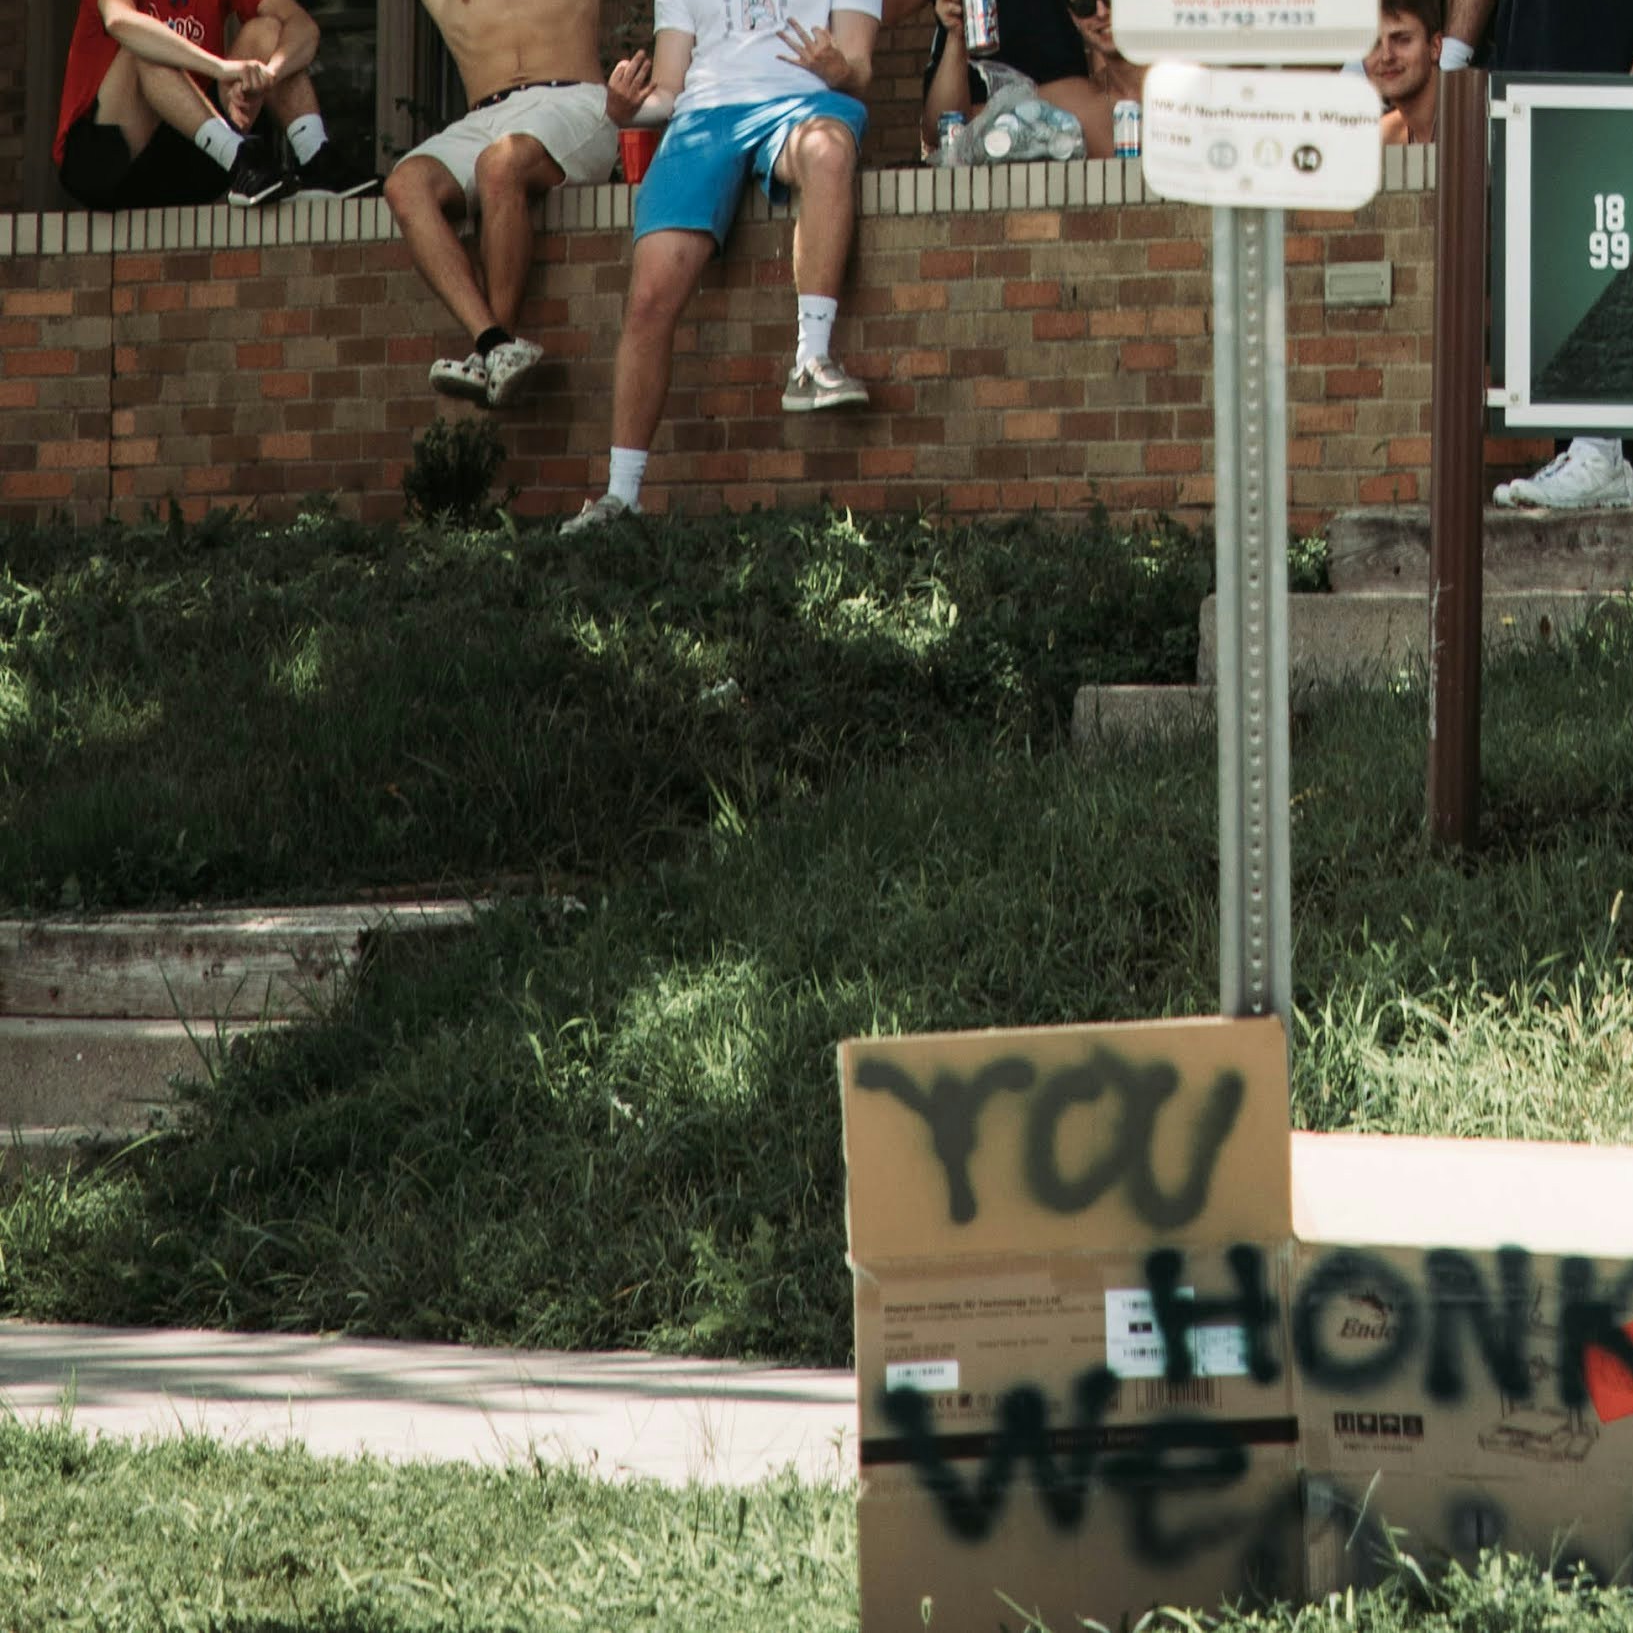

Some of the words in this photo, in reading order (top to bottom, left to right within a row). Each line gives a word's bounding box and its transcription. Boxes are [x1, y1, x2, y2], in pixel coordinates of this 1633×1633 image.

[1594, 193, 1626, 232] 18
[1589, 231, 1630, 270] 99
[854, 1044, 1246, 1230] YOU
[1340, 1316, 1394, 1340] Ende
